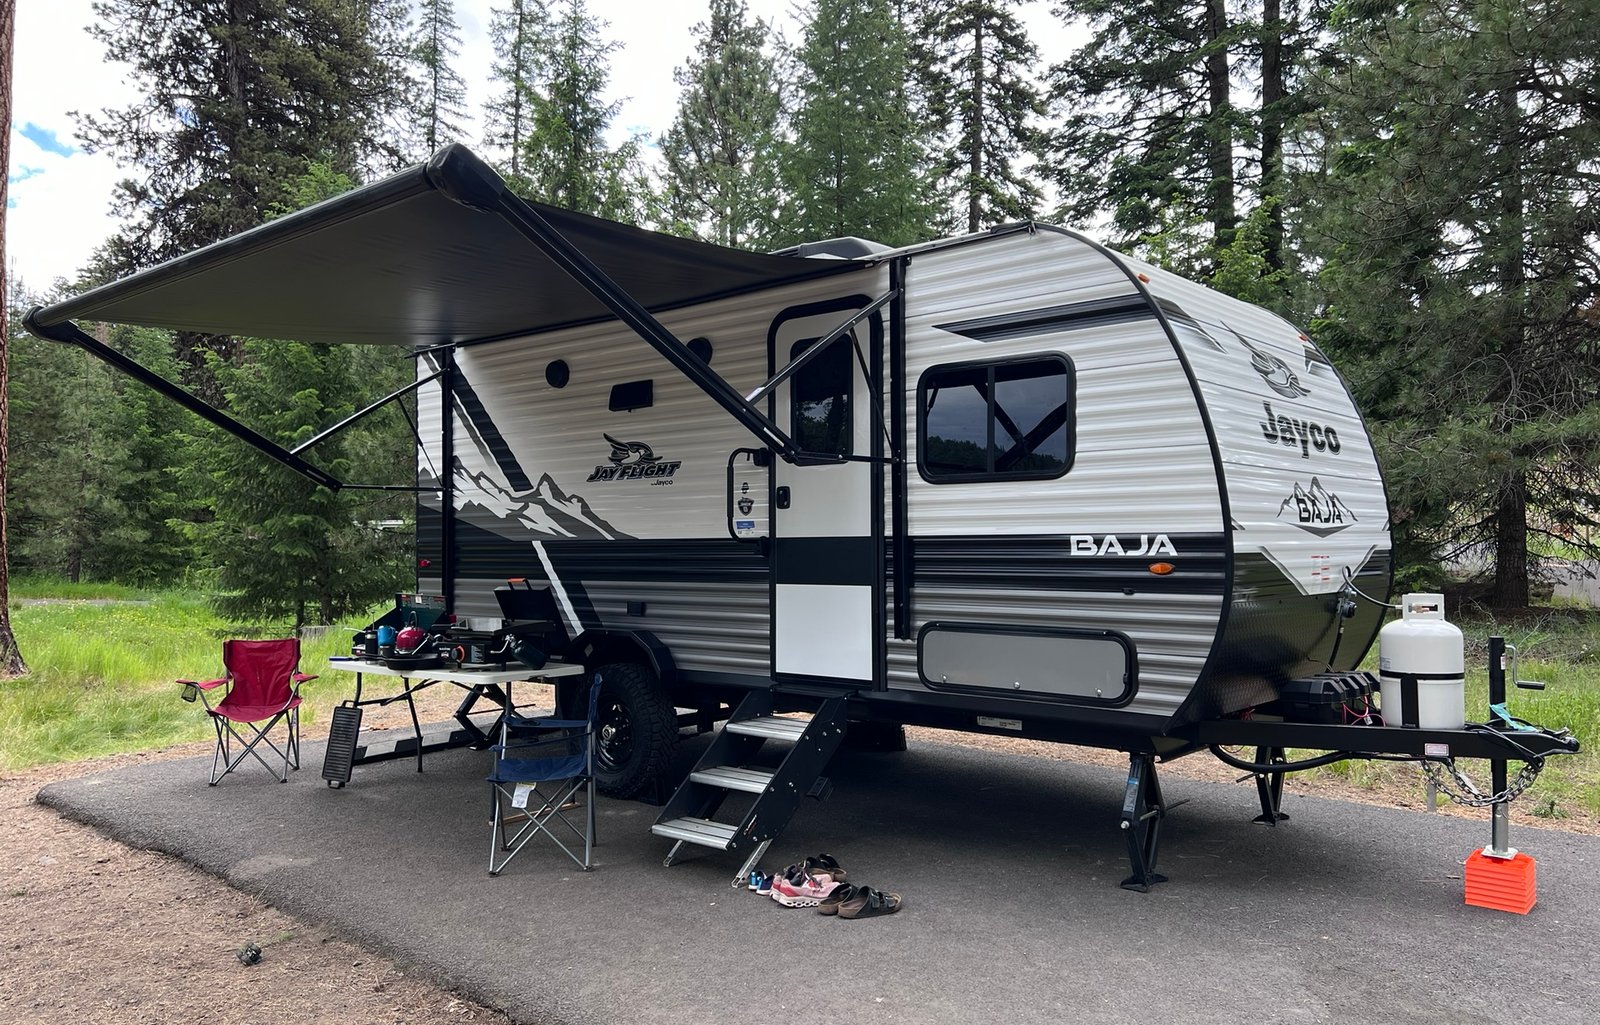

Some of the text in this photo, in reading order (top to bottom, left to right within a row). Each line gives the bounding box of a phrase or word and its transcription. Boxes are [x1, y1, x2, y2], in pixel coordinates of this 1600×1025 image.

[1260, 401, 1340, 458] Jayco
[587, 462, 681, 482] JAY FLIGHT
[1296, 498, 1342, 523] BAJA
[1070, 534, 1178, 556] BAJA
